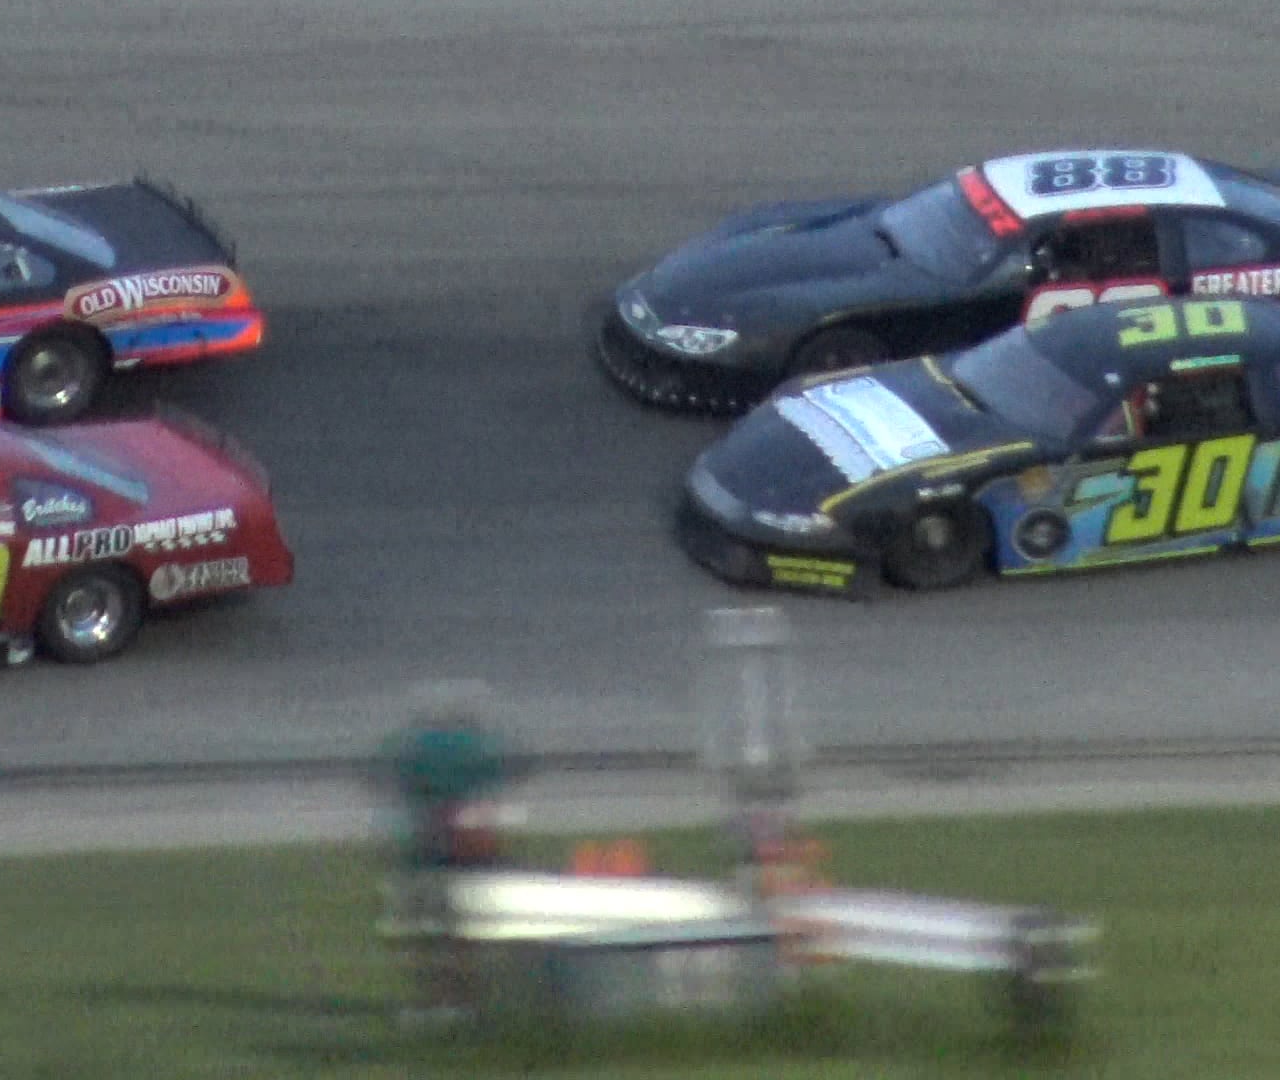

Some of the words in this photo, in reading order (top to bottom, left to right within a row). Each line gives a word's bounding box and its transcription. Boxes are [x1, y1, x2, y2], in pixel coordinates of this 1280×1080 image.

[1027, 155, 1176, 197] 88
[79, 287, 118, 316] OLD
[110, 273, 221, 311] WISCONSIN
[1118, 300, 1246, 345] 30
[1107, 433, 1256, 543] 30
